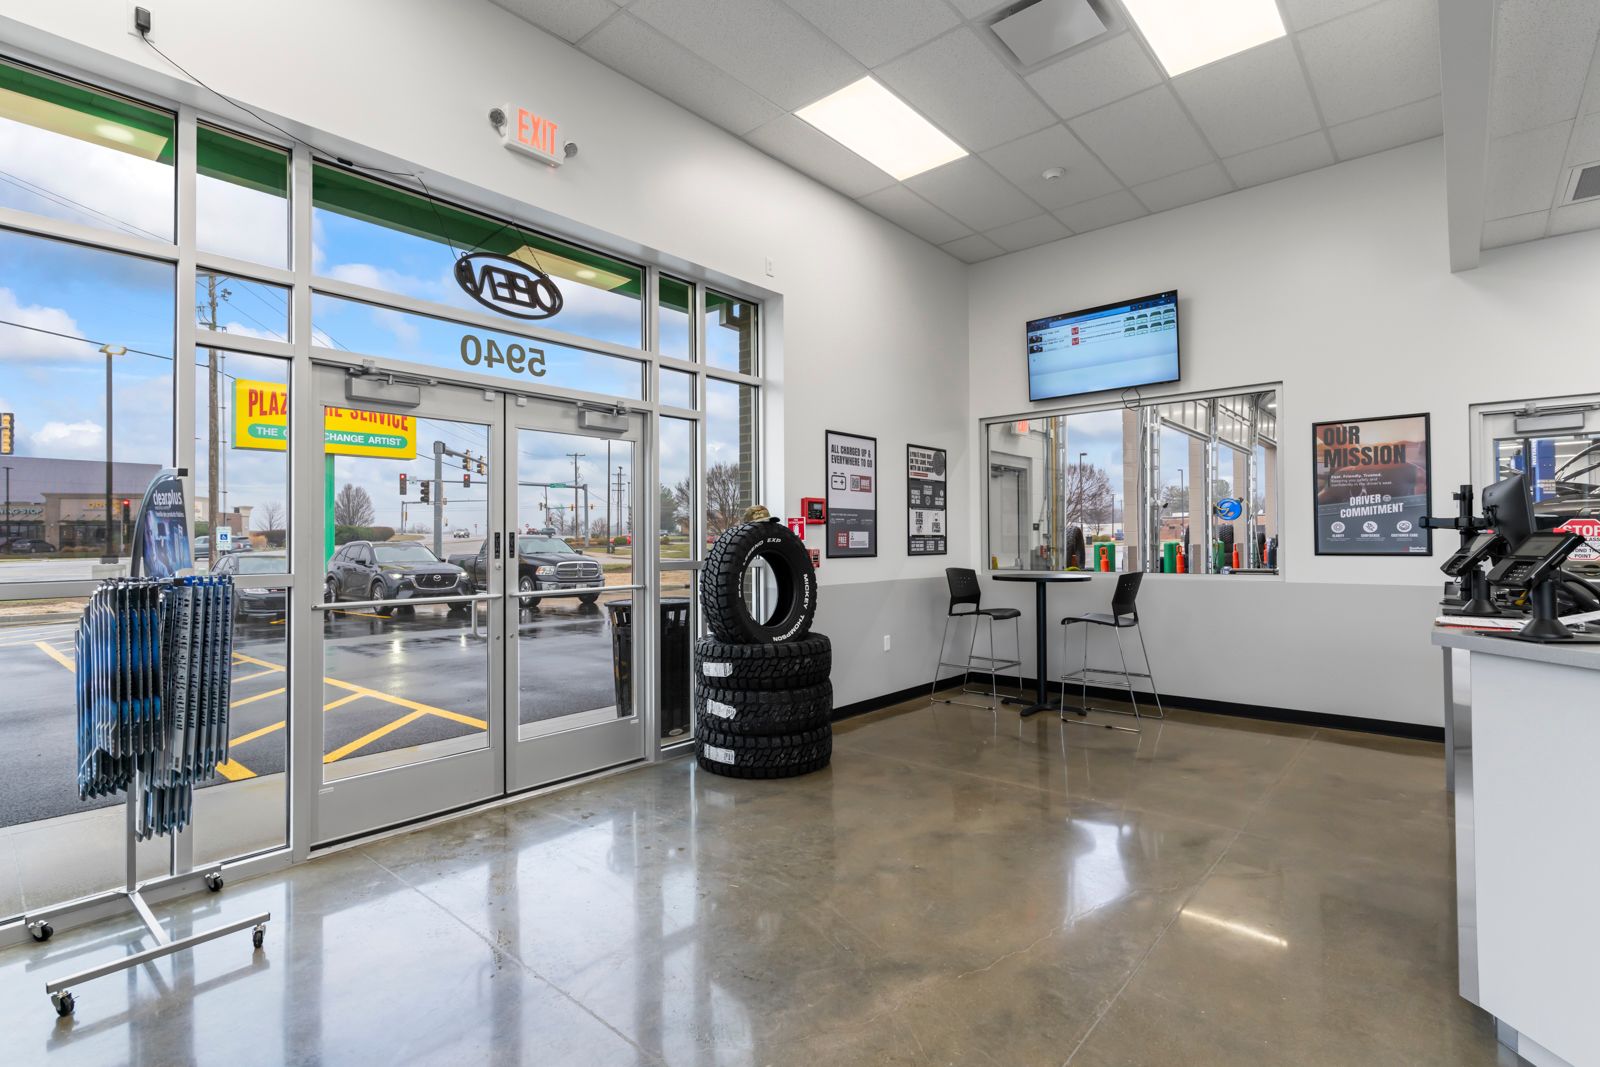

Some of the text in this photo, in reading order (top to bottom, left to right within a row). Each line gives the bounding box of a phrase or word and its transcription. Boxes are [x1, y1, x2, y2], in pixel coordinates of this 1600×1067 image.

[517, 108, 558, 155] EXIT
[248, 388, 287, 417] PLAZ
[256, 426, 278, 436] THE
[368, 436, 401, 446] ARTIST
[1323, 425, 1360, 446] OUR
[831, 444, 839, 454] ALL
[840, 446, 860, 456] CHARGED
[861, 448, 867, 457] UP
[831, 454, 860, 466] EVERYWHERE
[861, 458, 866, 467] TO
[1324, 444, 1406, 467] MISSION
[1349, 493, 1381, 506] DRIVER
[1340, 502, 1404, 518] COMMITMENT
[772, 614, 805, 642] THOMPSON
